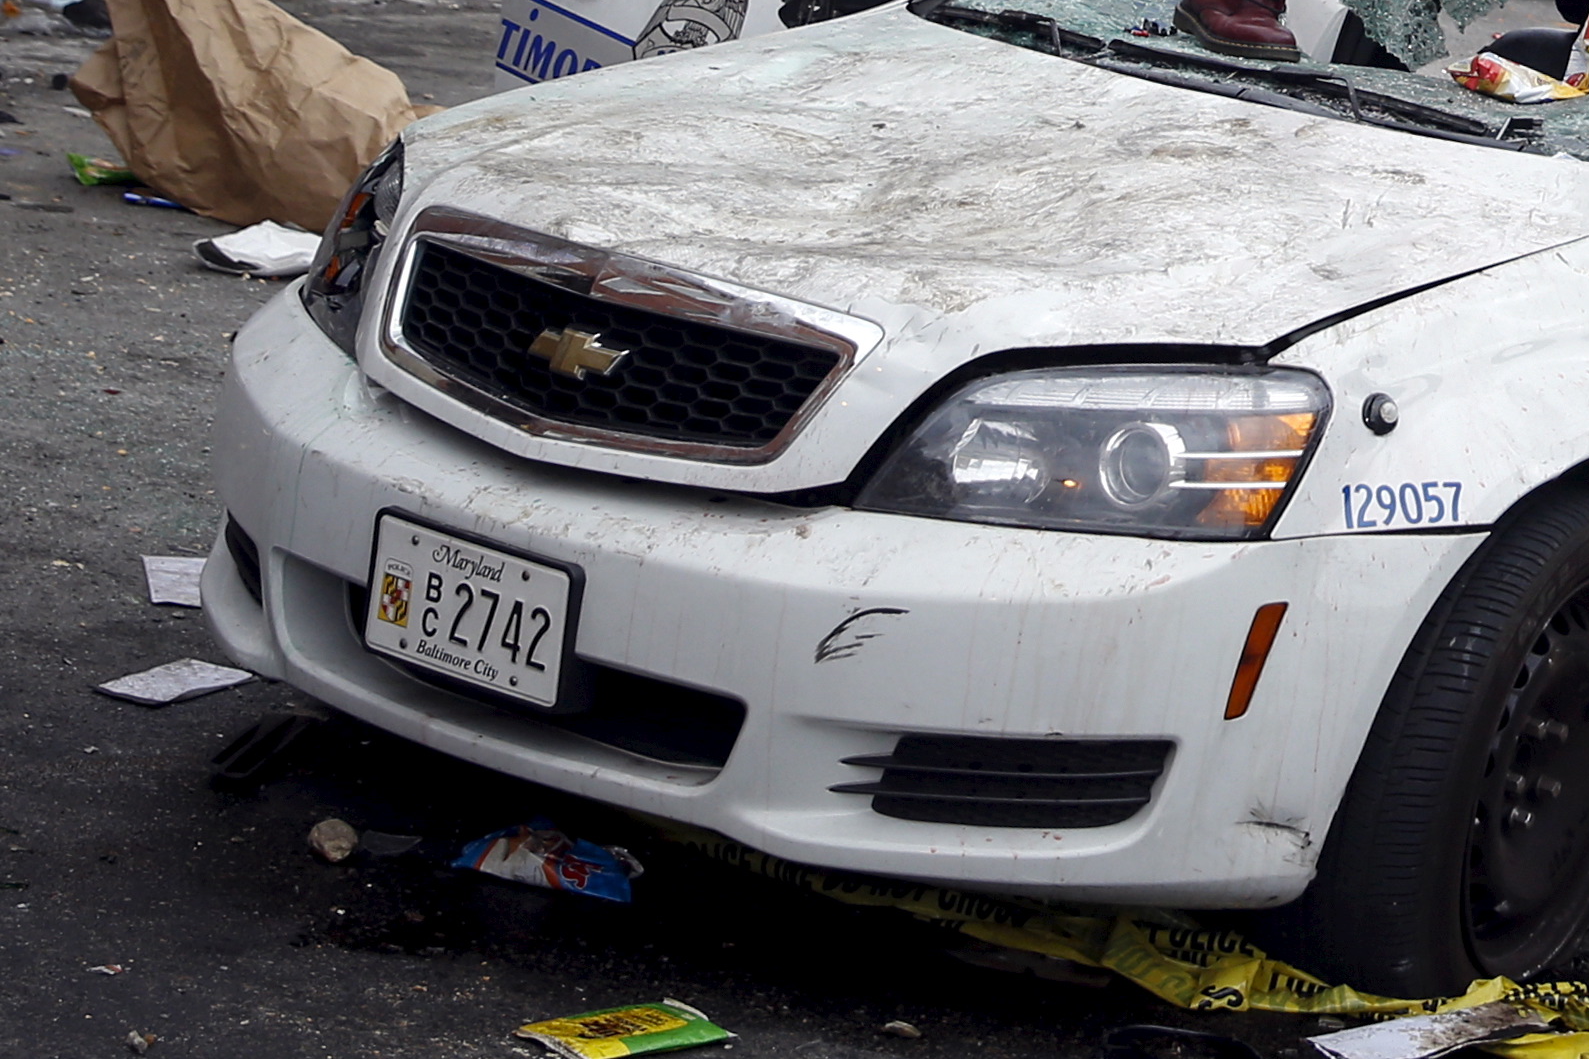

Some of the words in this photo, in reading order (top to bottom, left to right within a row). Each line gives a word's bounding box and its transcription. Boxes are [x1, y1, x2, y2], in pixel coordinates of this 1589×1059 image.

[1342, 481, 1462, 530] 129057
[387, 563, 412, 578] POLICE
[432, 543, 506, 583] Maryland
[449, 582, 551, 672] 2742
[416, 639, 472, 671] Baltimore
[473, 658, 499, 682] City
